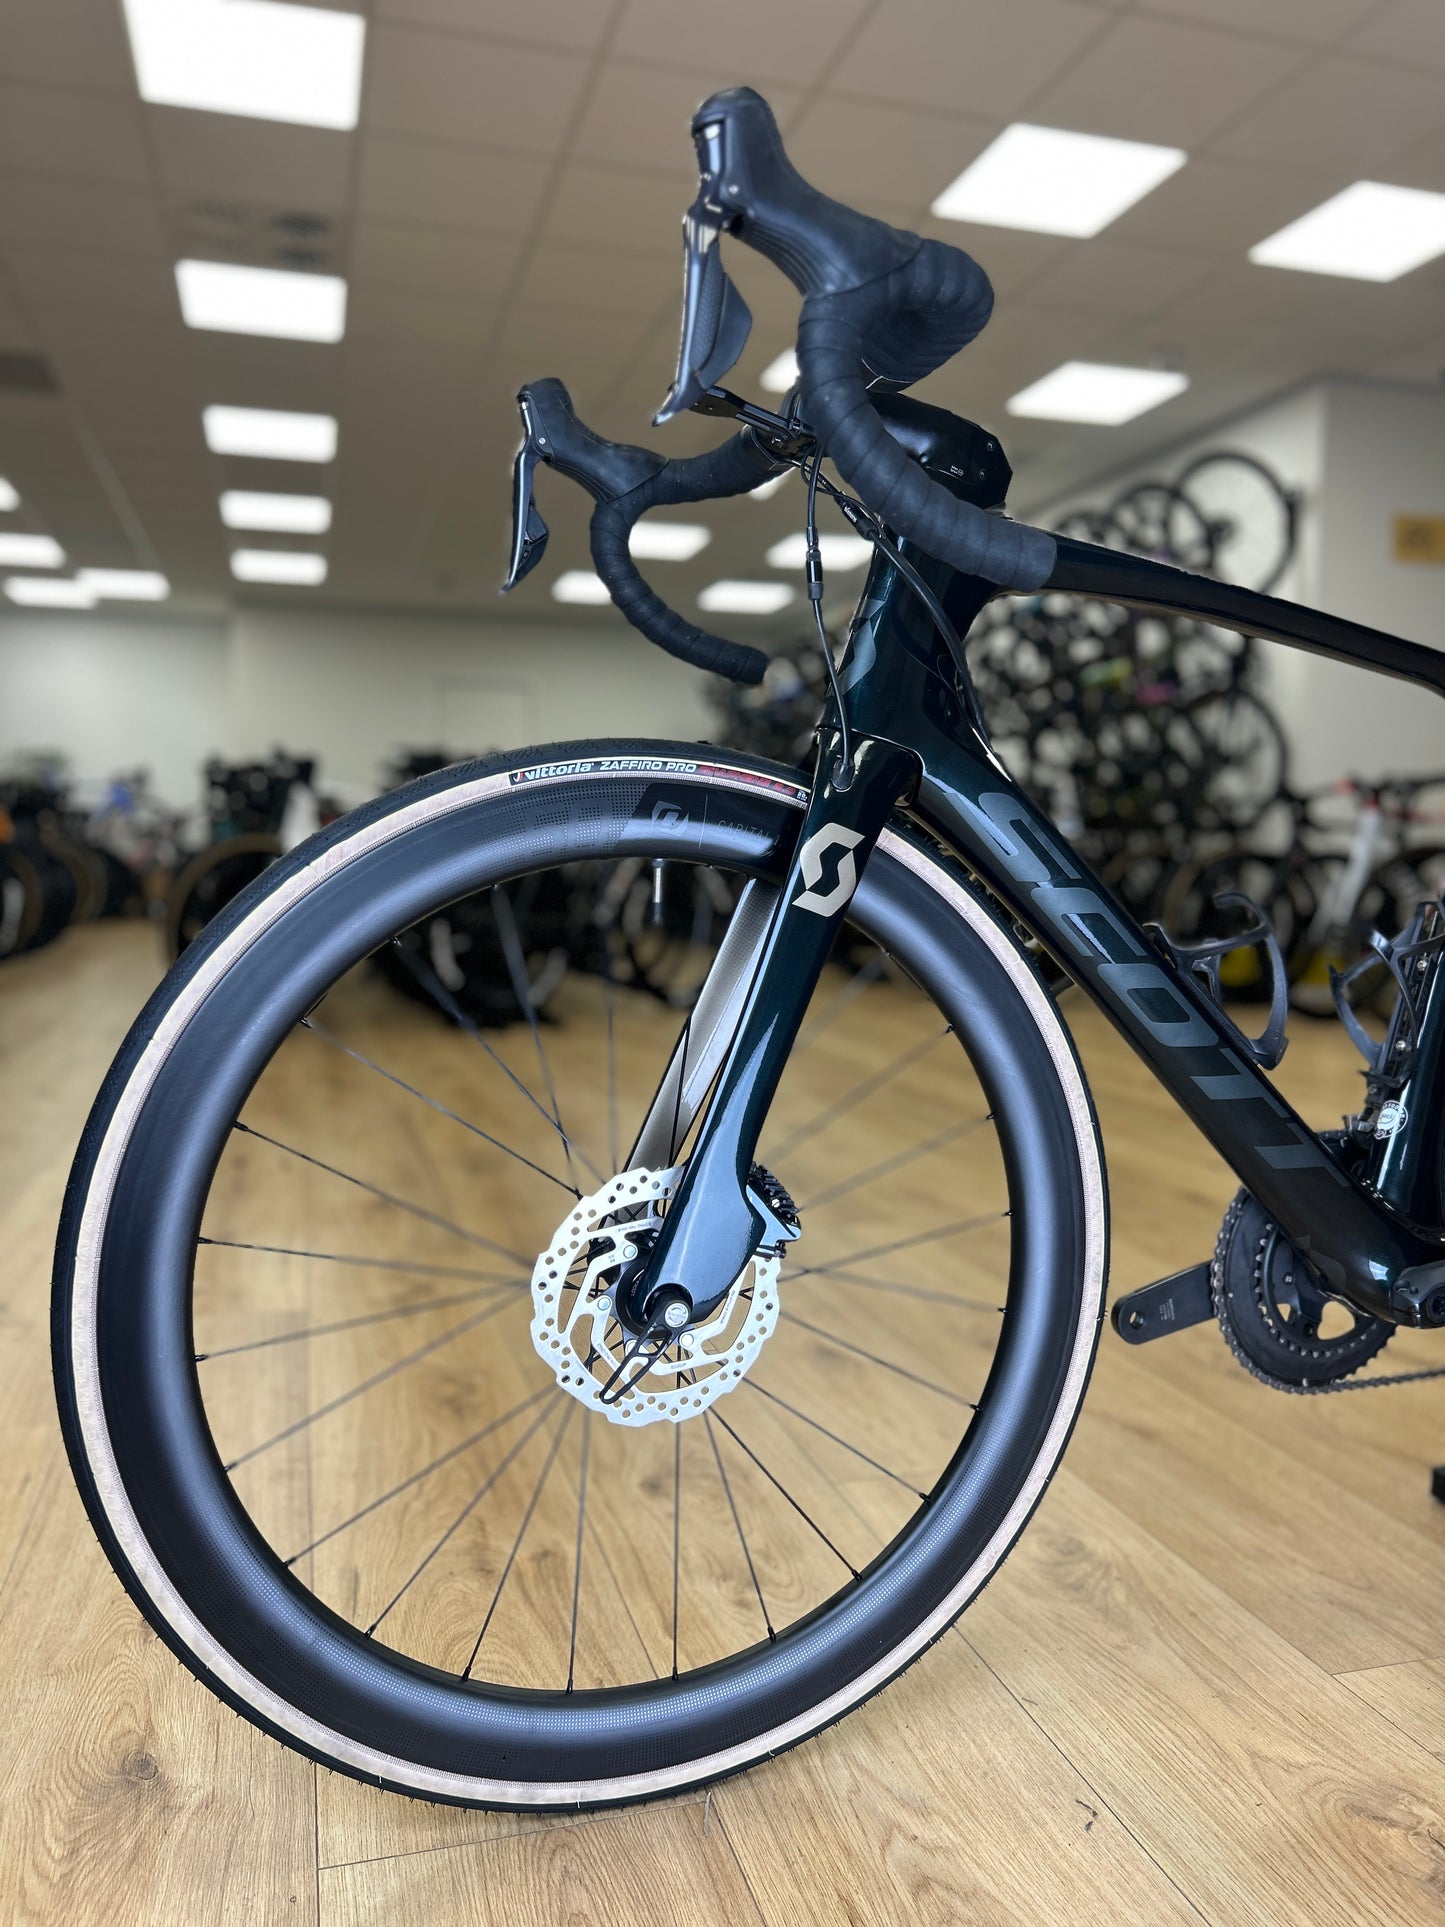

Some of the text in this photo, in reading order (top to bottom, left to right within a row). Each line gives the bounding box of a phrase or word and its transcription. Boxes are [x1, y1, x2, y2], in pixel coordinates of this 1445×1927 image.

[524, 763, 591, 779] vittoria
[600, 761, 663, 771] ZAFFIRO
[665, 762, 697, 773] PRO
[943, 792, 1351, 1188] SCOTT
